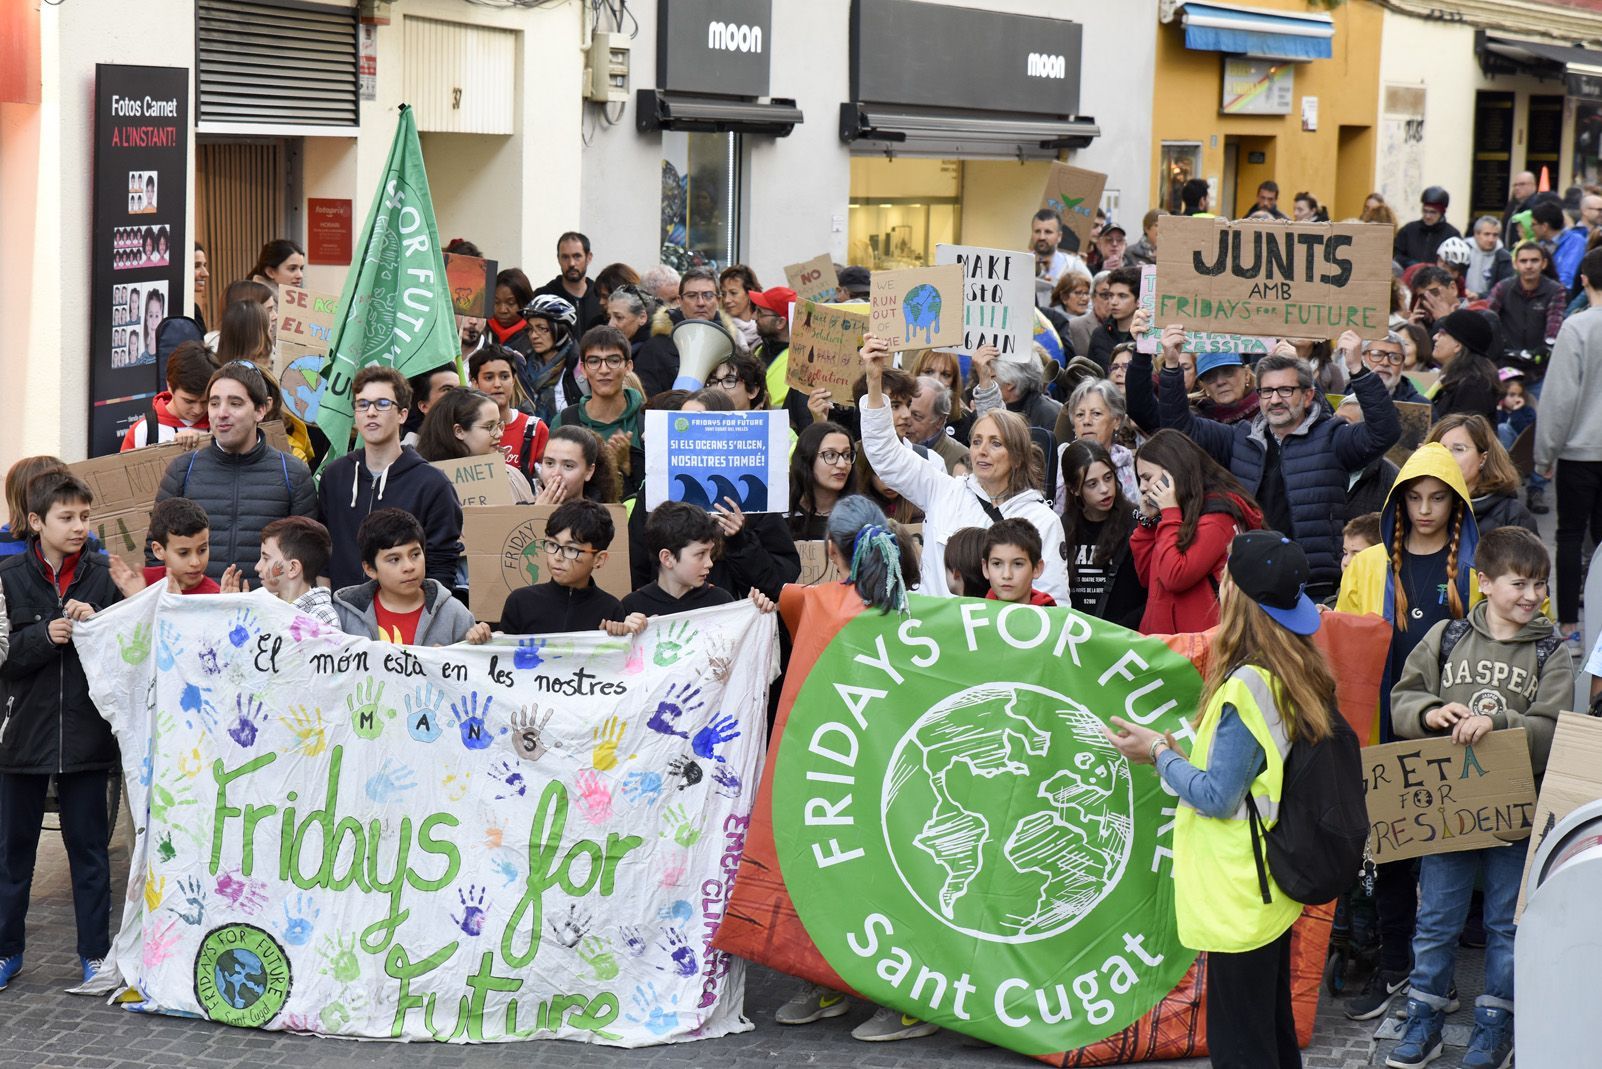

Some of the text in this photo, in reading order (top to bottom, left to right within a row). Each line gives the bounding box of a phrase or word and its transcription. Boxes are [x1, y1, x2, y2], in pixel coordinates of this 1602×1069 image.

[708, 21, 762, 53] moon
[1027, 52, 1066, 79] moon
[111, 94, 178, 117] Fotos Carnet
[453, 87, 463, 110] 37
[112, 126, 177, 147] A L'INSTANT!
[956, 253, 1012, 281] MAKE
[1193, 229, 1354, 288] JUNTS
[800, 268, 822, 286] NO
[877, 279, 896, 291] WE
[285, 289, 309, 309] SE
[872, 295, 897, 308] RUN
[1248, 282, 1292, 300] AMB
[281, 316, 305, 335] EL
[872, 308, 897, 320] OUT
[1256, 305, 1278, 315] FOR
[1284, 303, 1378, 329] FUTURE
[877, 321, 892, 332] OF
[670, 439, 679, 450] SI
[680, 440, 694, 450] ELS
[695, 440, 728, 450] OCEANS
[671, 452, 765, 467] NOSALTRES TAMBÉ!
[254, 633, 628, 696] El món està en les nostres
[1442, 659, 1540, 703] JASPER
[804, 618, 941, 869] FRIDAYS
[960, 602, 1093, 667] FOR
[208, 745, 644, 969] Fridays for
[199, 930, 286, 1011] FRIDAYS FOR FUTURE
[845, 911, 1165, 1027] Sant Cugat
[385, 941, 624, 1042] Future
